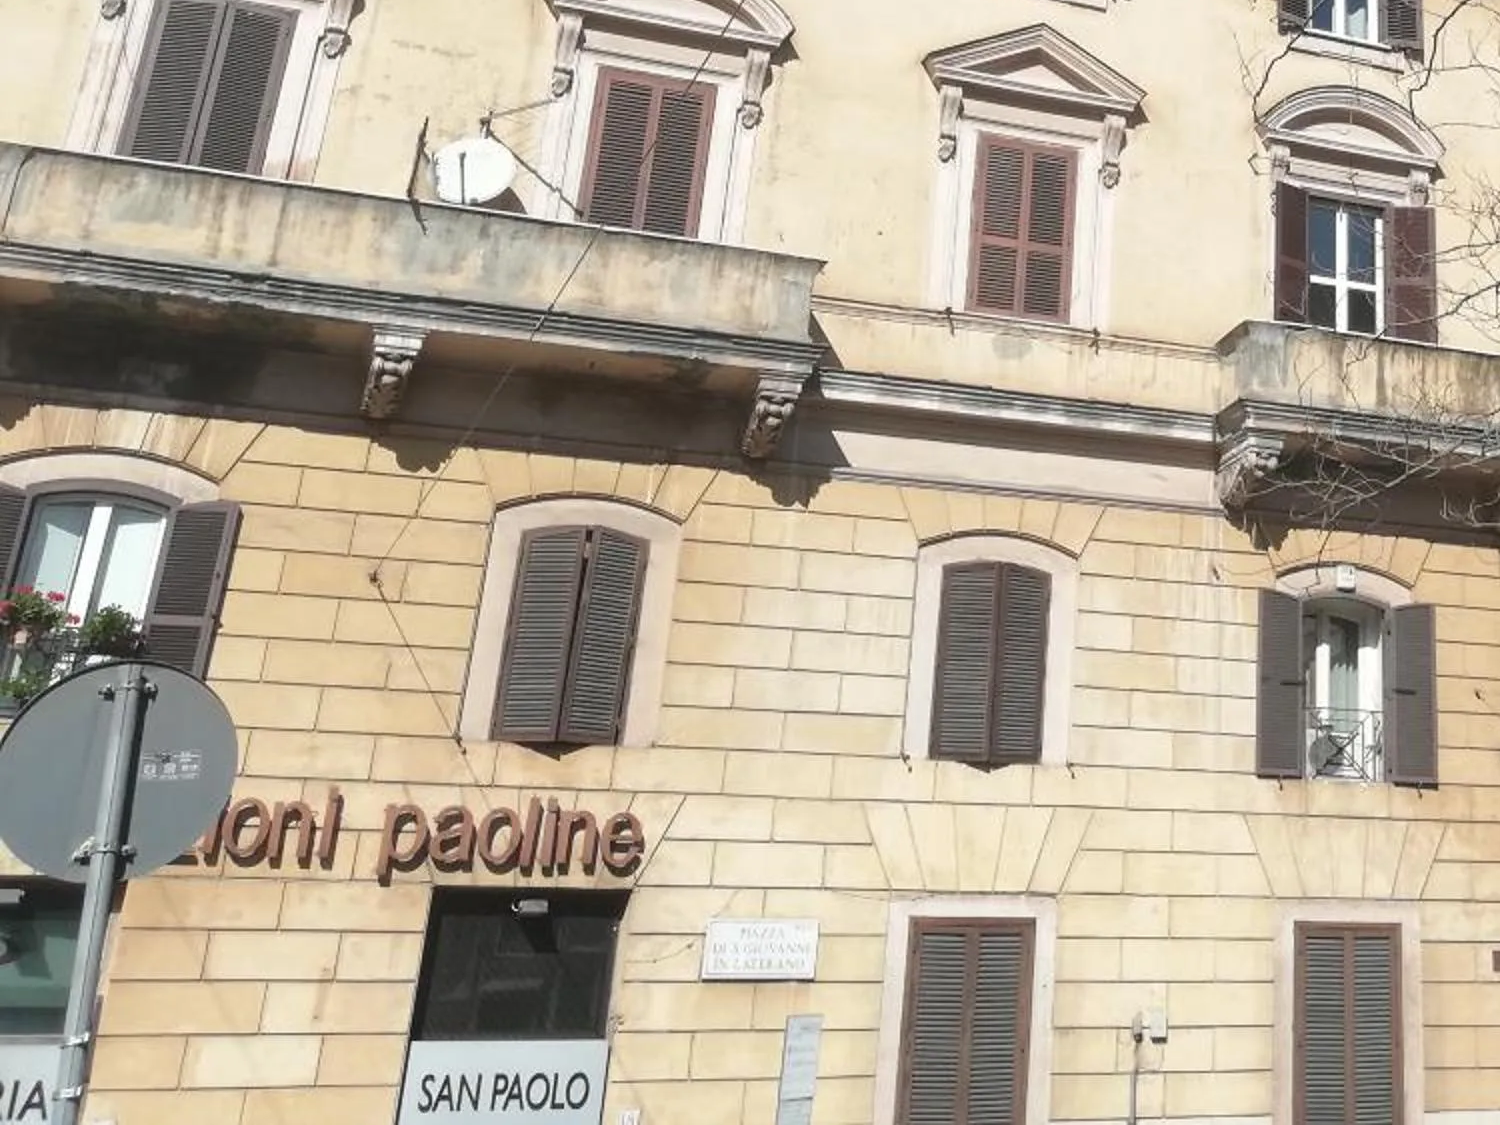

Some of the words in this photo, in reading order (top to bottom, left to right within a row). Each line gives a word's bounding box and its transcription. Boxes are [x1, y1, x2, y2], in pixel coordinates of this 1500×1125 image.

[377, 794, 645, 886] paoline
[417, 1072, 483, 1113] SAN
[490, 1071, 591, 1112] PAOLO
